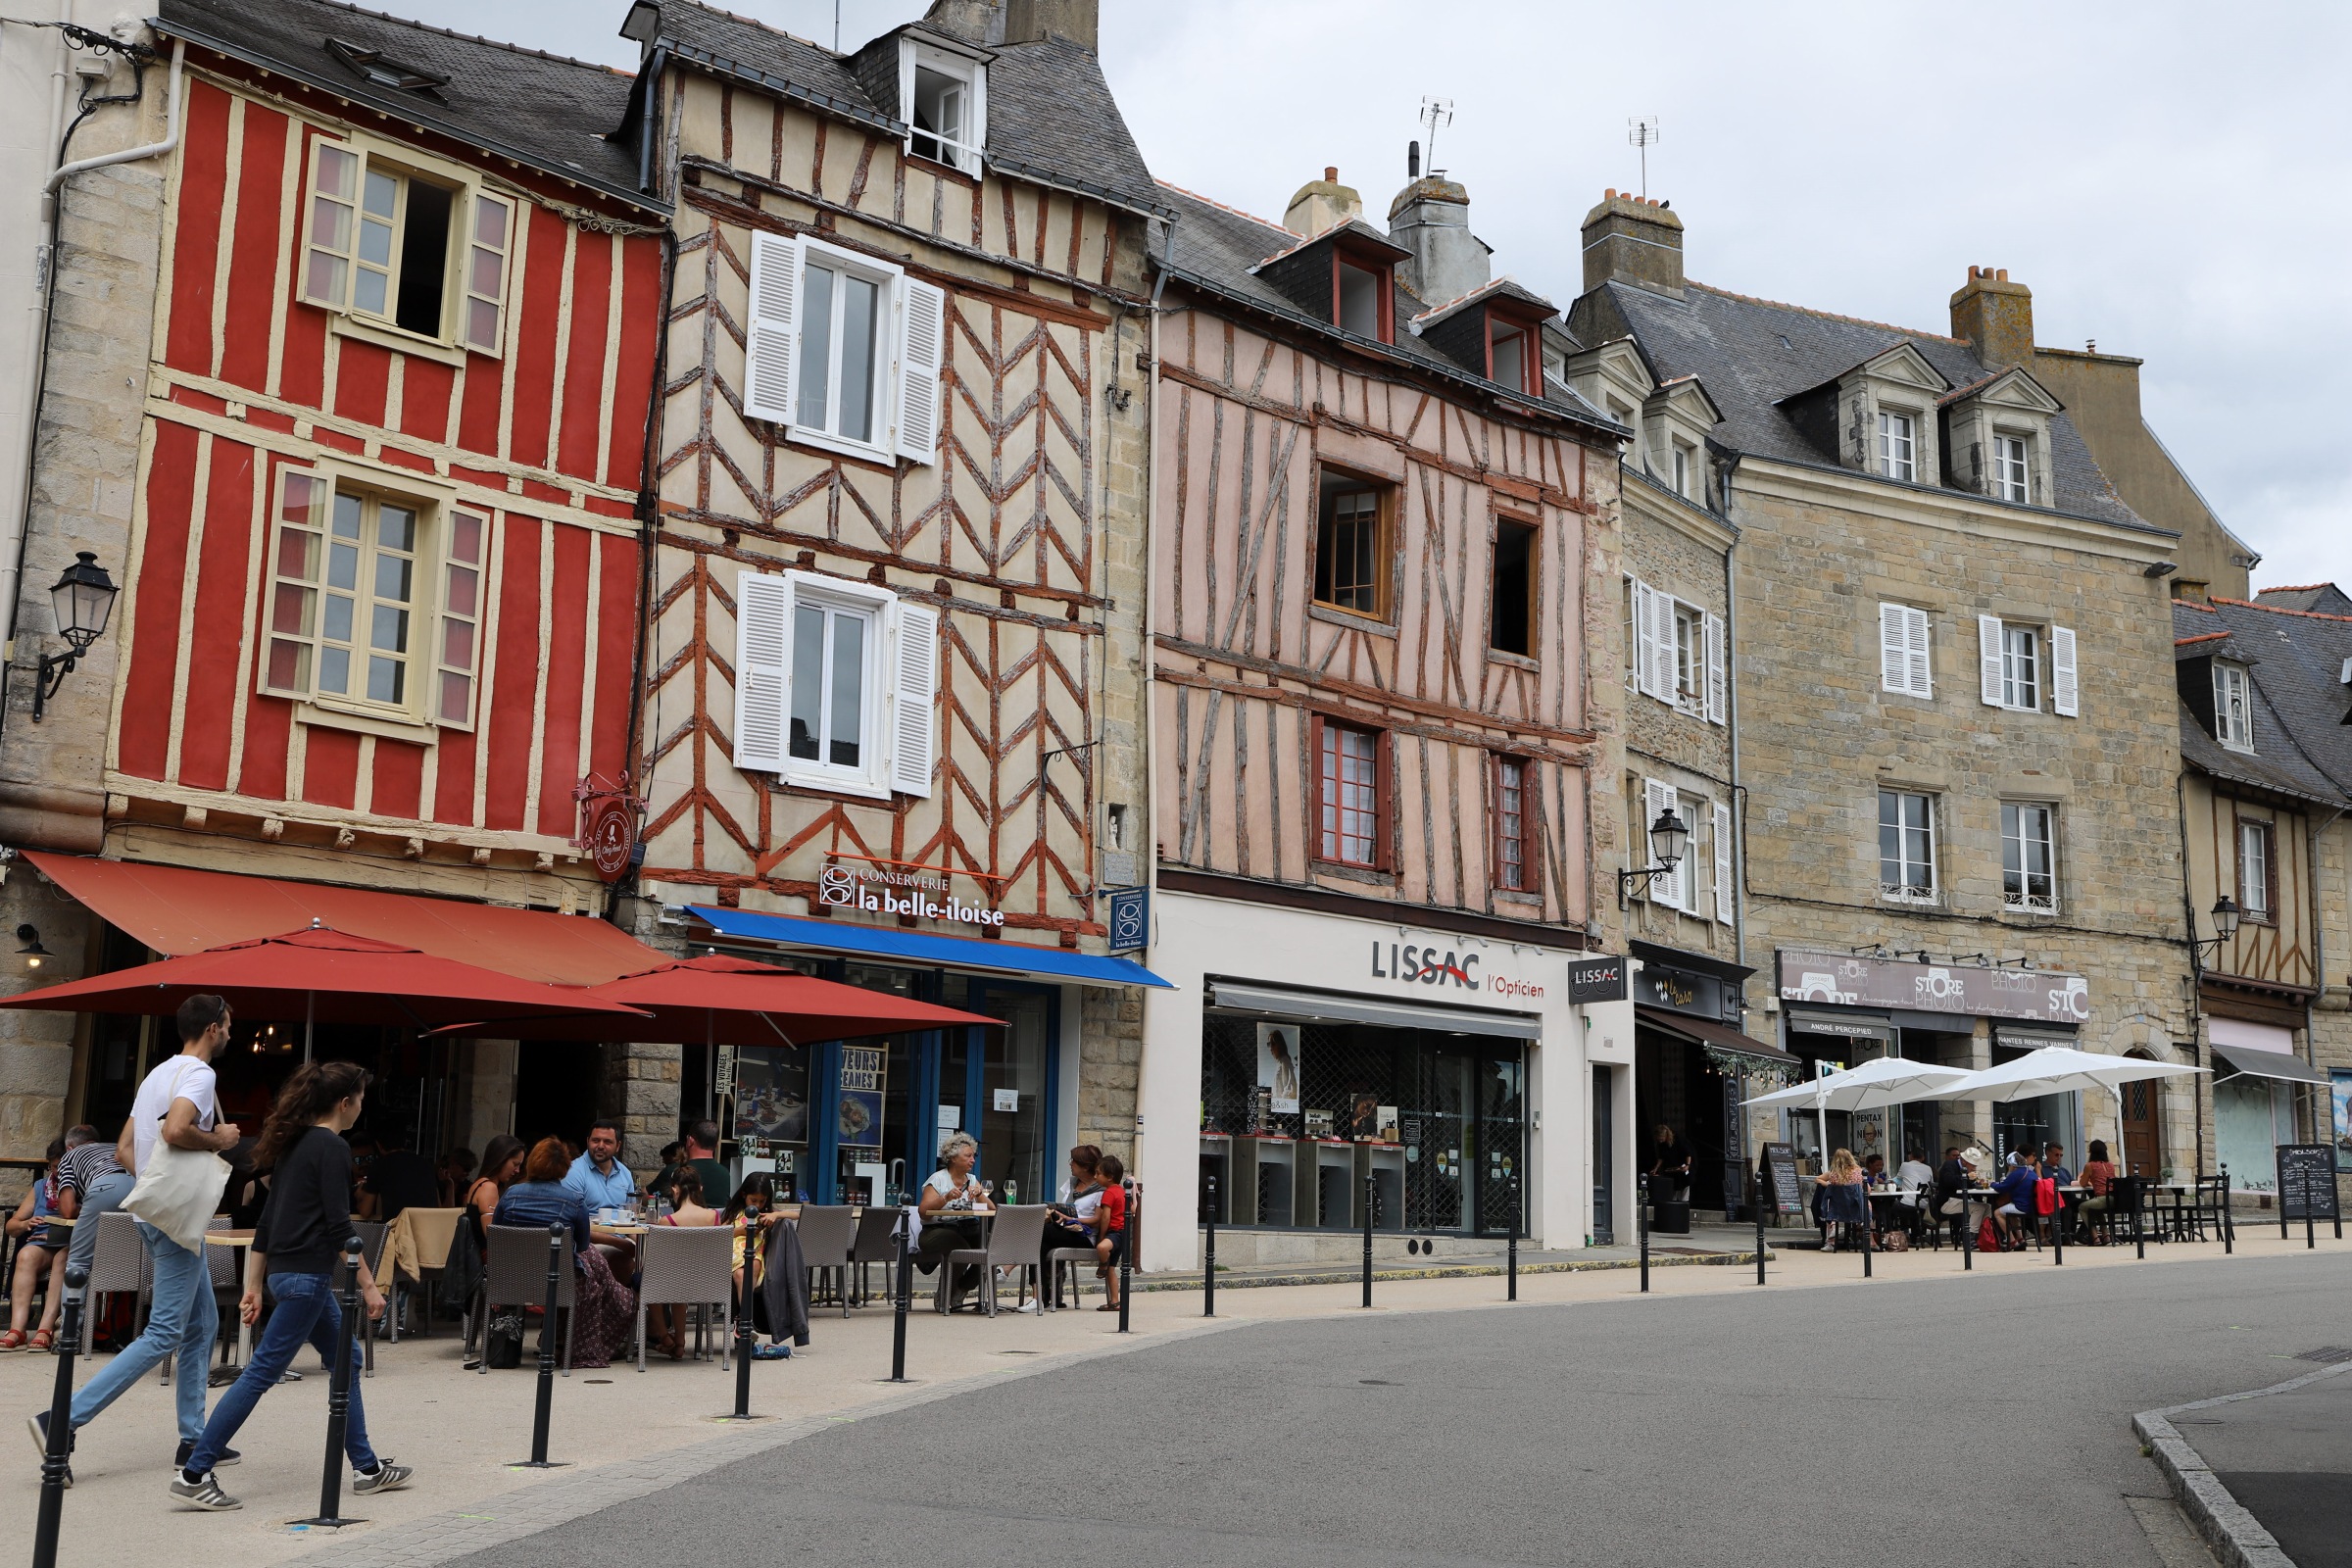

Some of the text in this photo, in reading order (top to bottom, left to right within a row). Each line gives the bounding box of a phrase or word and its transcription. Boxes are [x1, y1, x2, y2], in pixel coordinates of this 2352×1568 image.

[859, 867, 949, 892] CONSERVERIE
[858, 884, 1004, 927] la belle-iloise
[1116, 893, 1143, 902] CONSERVERIE
[1372, 941, 1479, 990] LISSAC
[1838, 964, 1868, 978] STORE
[1575, 967, 1618, 985] LISSAC
[1488, 974, 1544, 999] l'Opticien
[1915, 975, 1964, 999] STORE
[1916, 991, 1965, 1009] PHOTO
[1810, 1022, 1872, 1035] ANDRÉ PERCEPIED
[1998, 1036, 2023, 1045] NANTES
[717, 1053, 727, 1081] VOYAGES
[1856, 1113, 1882, 1123] PENTAX
